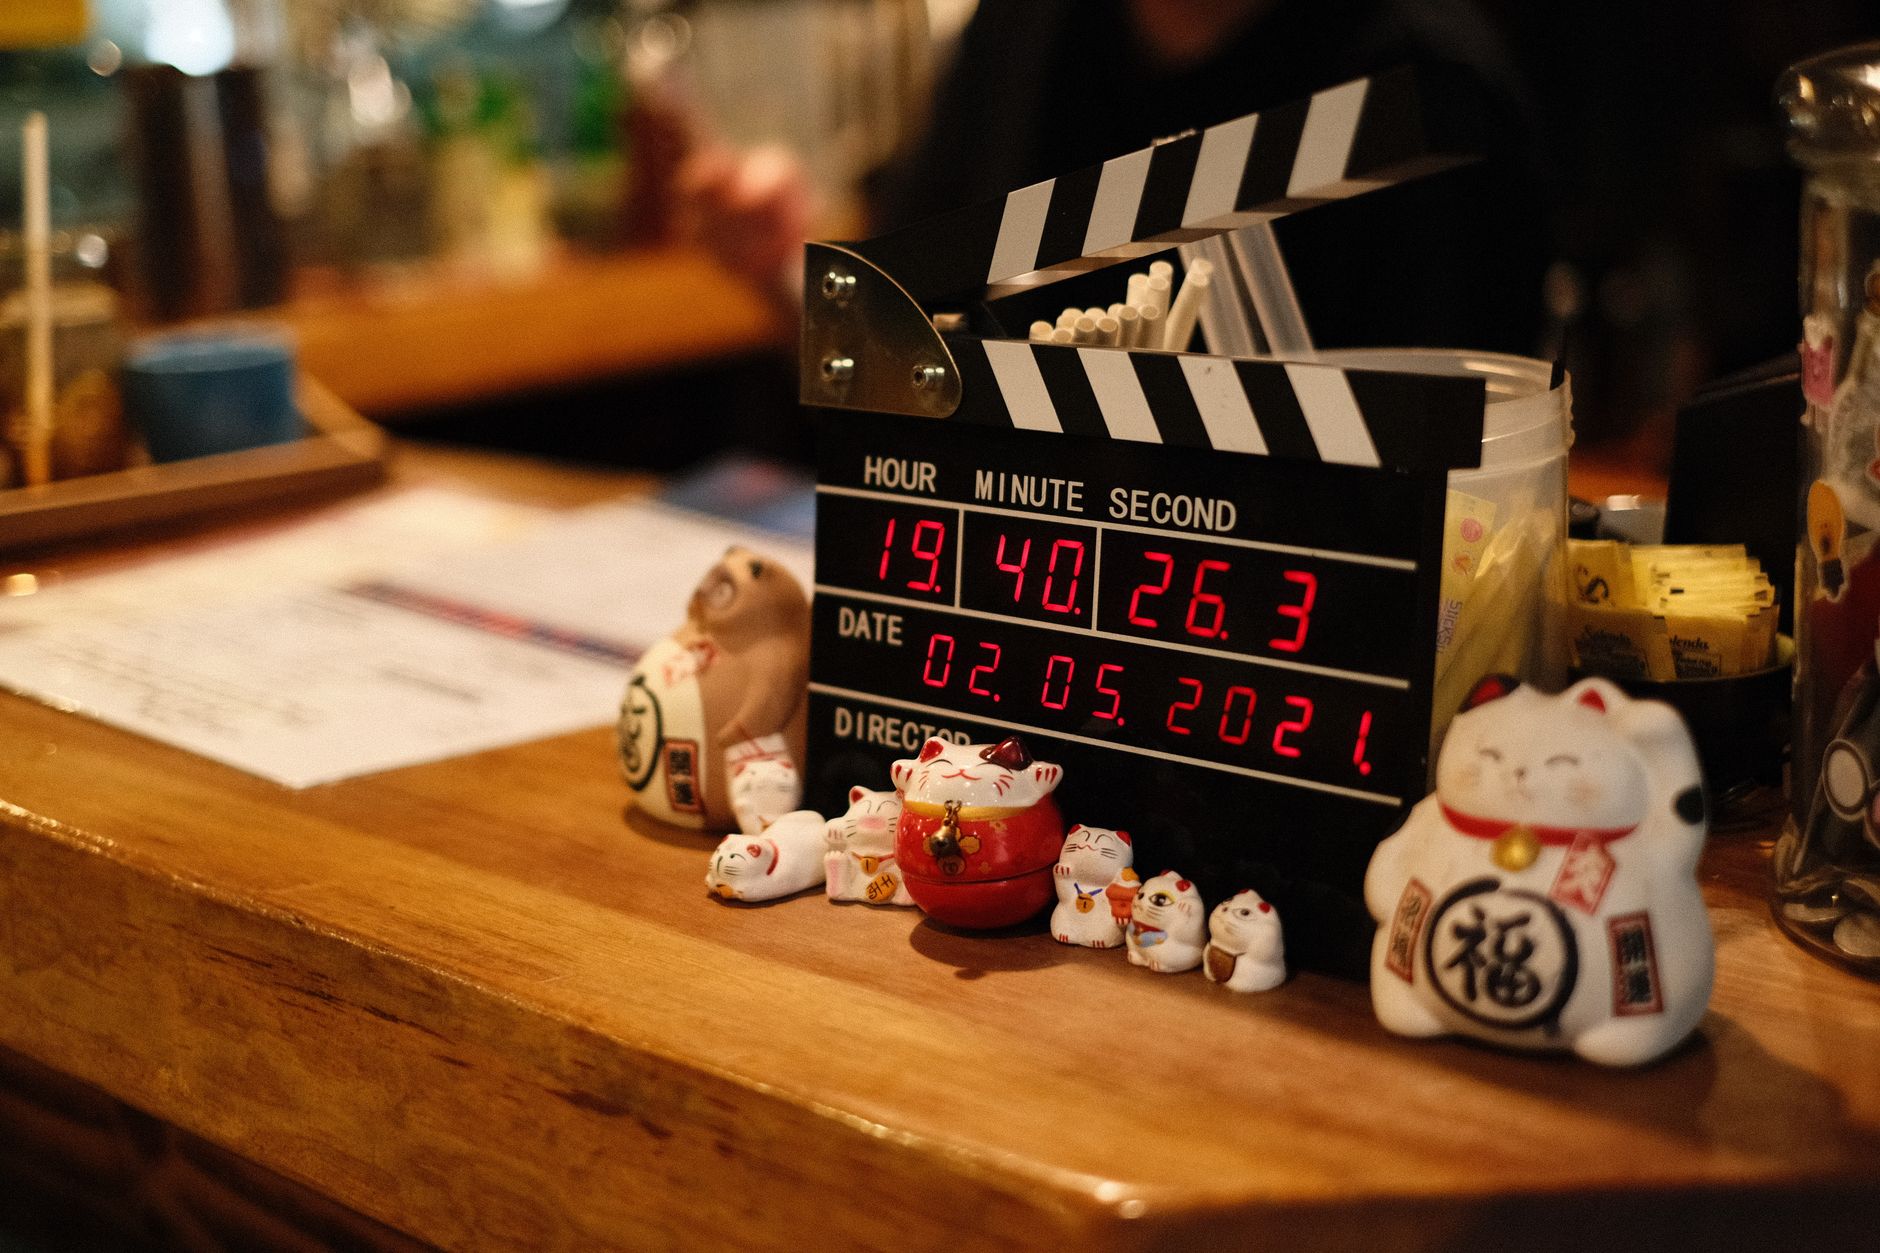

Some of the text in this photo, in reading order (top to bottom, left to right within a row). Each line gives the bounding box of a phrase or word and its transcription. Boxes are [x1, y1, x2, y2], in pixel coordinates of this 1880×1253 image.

[864, 455, 1237, 532] HOUR MINUTE SECOND
[838, 606, 903, 646] DATE
